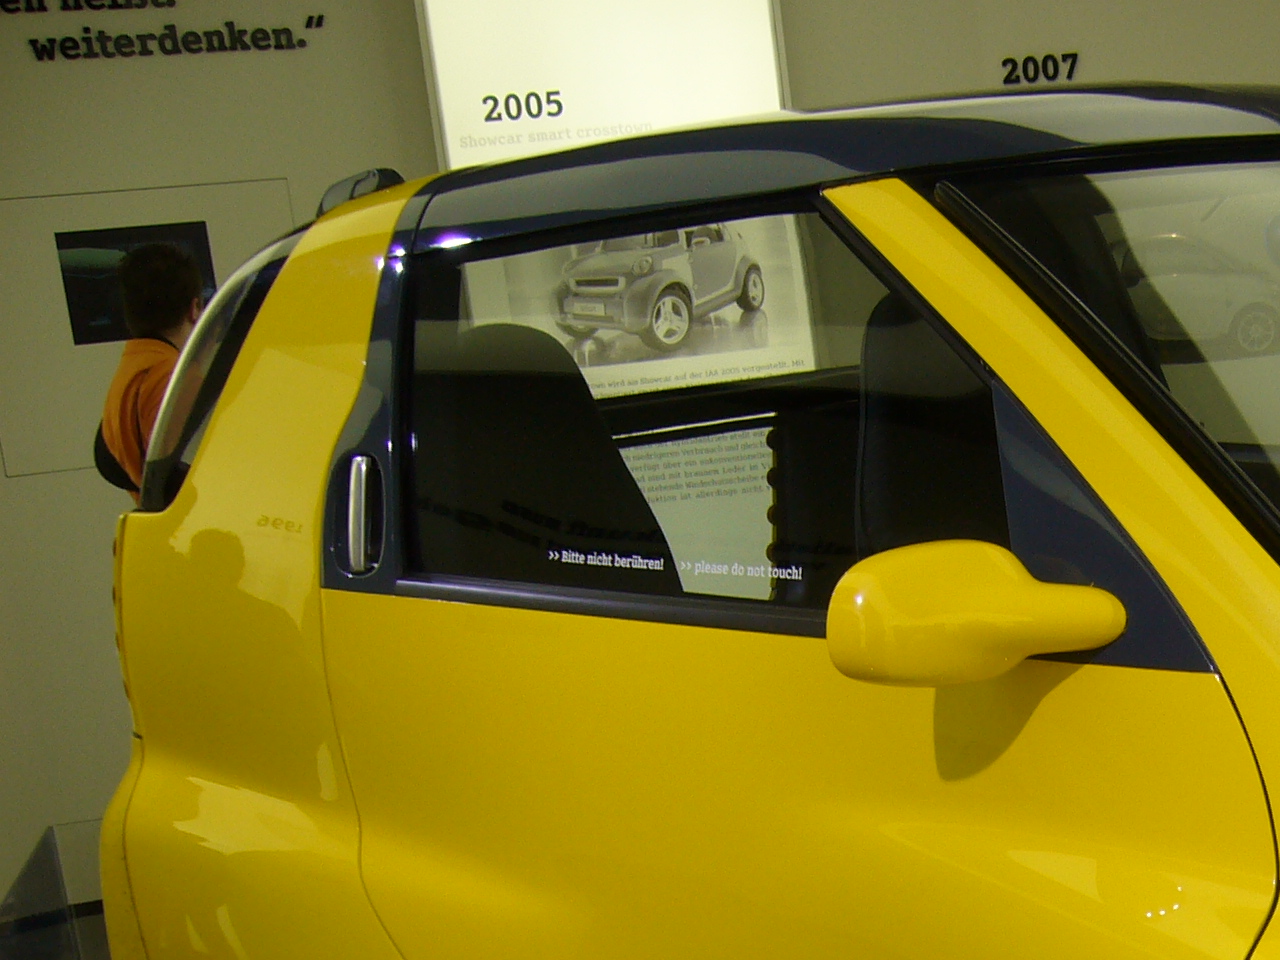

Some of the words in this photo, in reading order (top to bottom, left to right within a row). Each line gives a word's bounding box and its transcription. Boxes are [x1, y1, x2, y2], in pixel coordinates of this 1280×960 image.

[1001, 52, 1078, 84] 2007
[481, 89, 564, 122] 2005
[459, 132, 523, 149] Showcar
[527, 127, 573, 144] smart
[576, 122, 654, 140] crosstown
[561, 550, 586, 565] Bitte
[587, 553, 613, 567] nicht
[614, 554, 664, 571] berühren!
[693, 559, 729, 576] please
[731, 562, 744, 576] do
[747, 563, 765, 577] not
[768, 565, 802, 581] touch!
